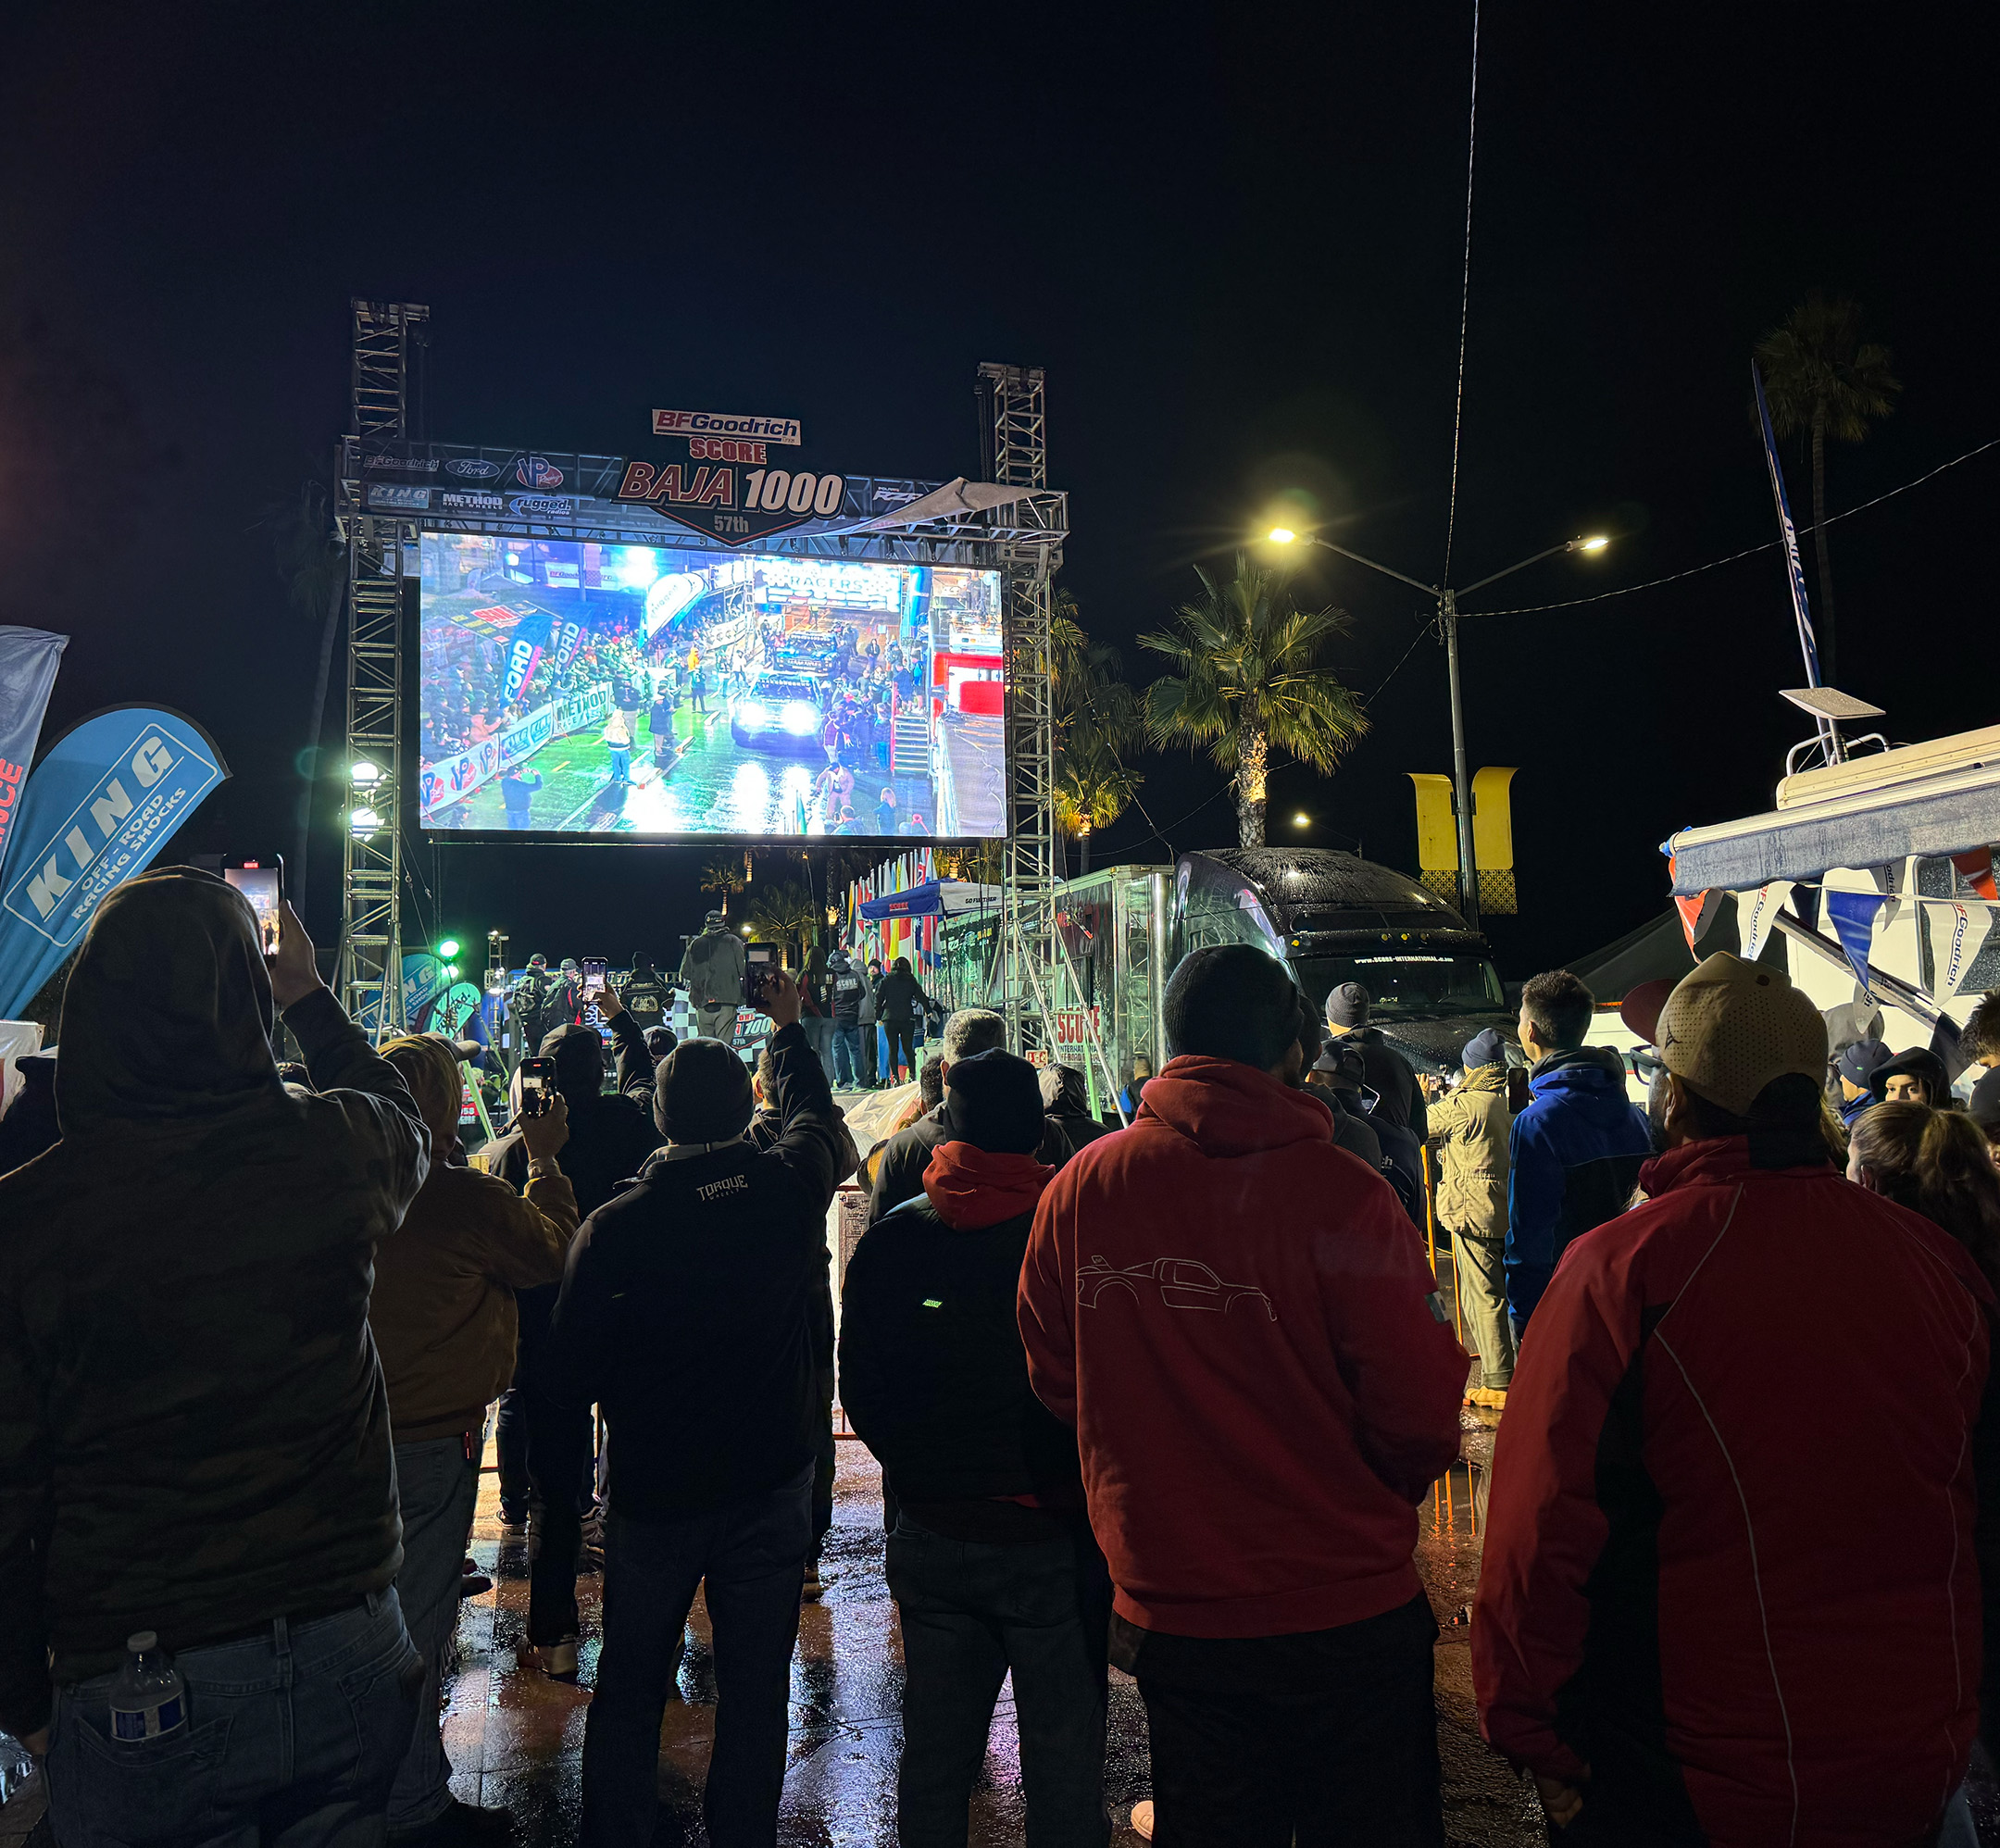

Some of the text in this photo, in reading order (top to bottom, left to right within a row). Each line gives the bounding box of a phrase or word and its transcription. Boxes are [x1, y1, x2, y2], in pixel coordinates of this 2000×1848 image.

[656, 411, 797, 437] BFGoodrich
[690, 437, 768, 465] SCORE
[457, 461, 489, 475] Ford
[518, 456, 550, 488] VP
[371, 487, 426, 499] KING
[443, 493, 503, 506] METHOD
[619, 461, 844, 515] BAJA 1000
[714, 515, 750, 534] 57th
[791, 575, 863, 591] RACERS
[555, 622, 580, 675] FORD
[504, 640, 533, 703] FORD
[556, 691, 606, 721] METHOD
[26, 736, 174, 918] KING
[71, 787, 187, 920] RACING SHOCKS
[81, 853, 112, 892] OFF
[118, 793, 165, 846] ROAD
[696, 1174, 748, 1201] TORQUE
